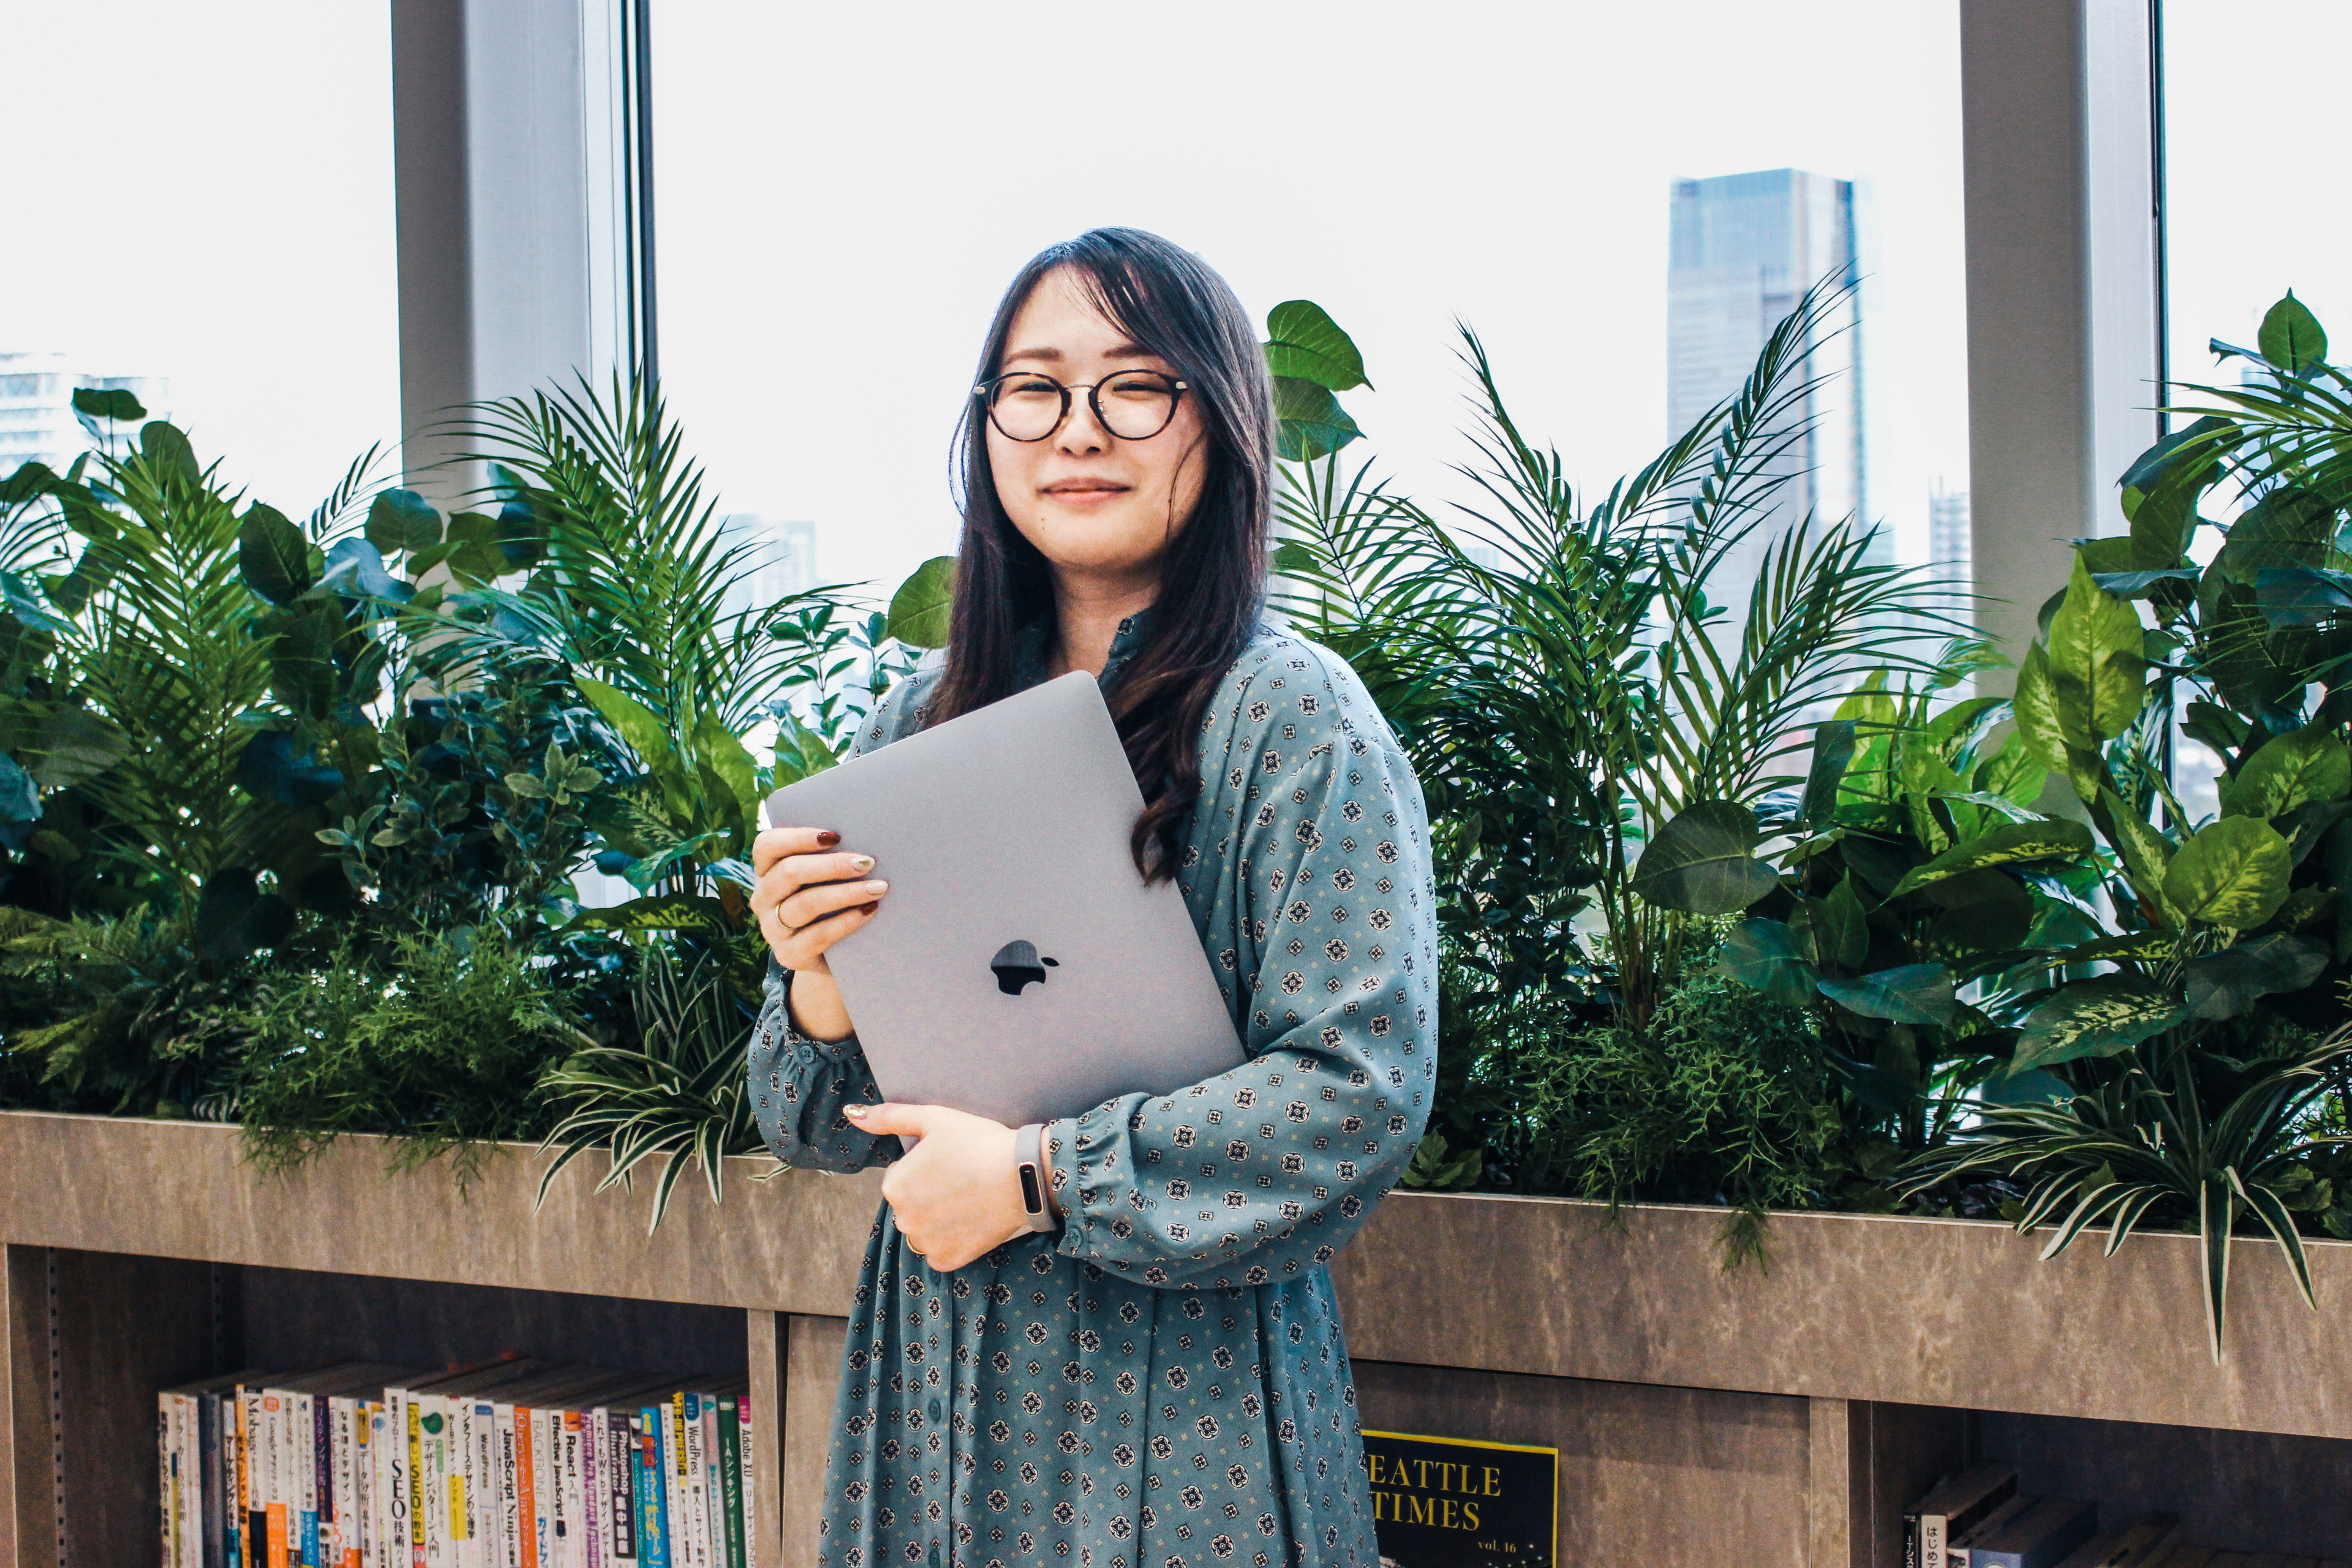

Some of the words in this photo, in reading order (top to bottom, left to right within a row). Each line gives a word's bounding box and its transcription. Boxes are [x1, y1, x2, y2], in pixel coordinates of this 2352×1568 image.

[247, 1398, 260, 1451] Mobage
[584, 1414, 595, 1457] Premiere
[742, 1430, 752, 1460] Adobe
[481, 1434, 490, 1489] WordPress
[503, 1428, 516, 1500] JavaScript
[567, 1435, 577, 1477] React
[587, 1460, 596, 1476] Pro
[619, 1431, 630, 1495] Photoshop
[688, 1426, 701, 1475] WordPress
[554, 1465, 564, 1517] JavaScript
[568, 1480, 579, 1506] 入門
[1367, 1454, 1501, 1496] EATTLE
[1371, 1491, 1480, 1531] TIMES
[1478, 1540, 1500, 1551] vol.
[1504, 1542, 1517, 1553] 16
